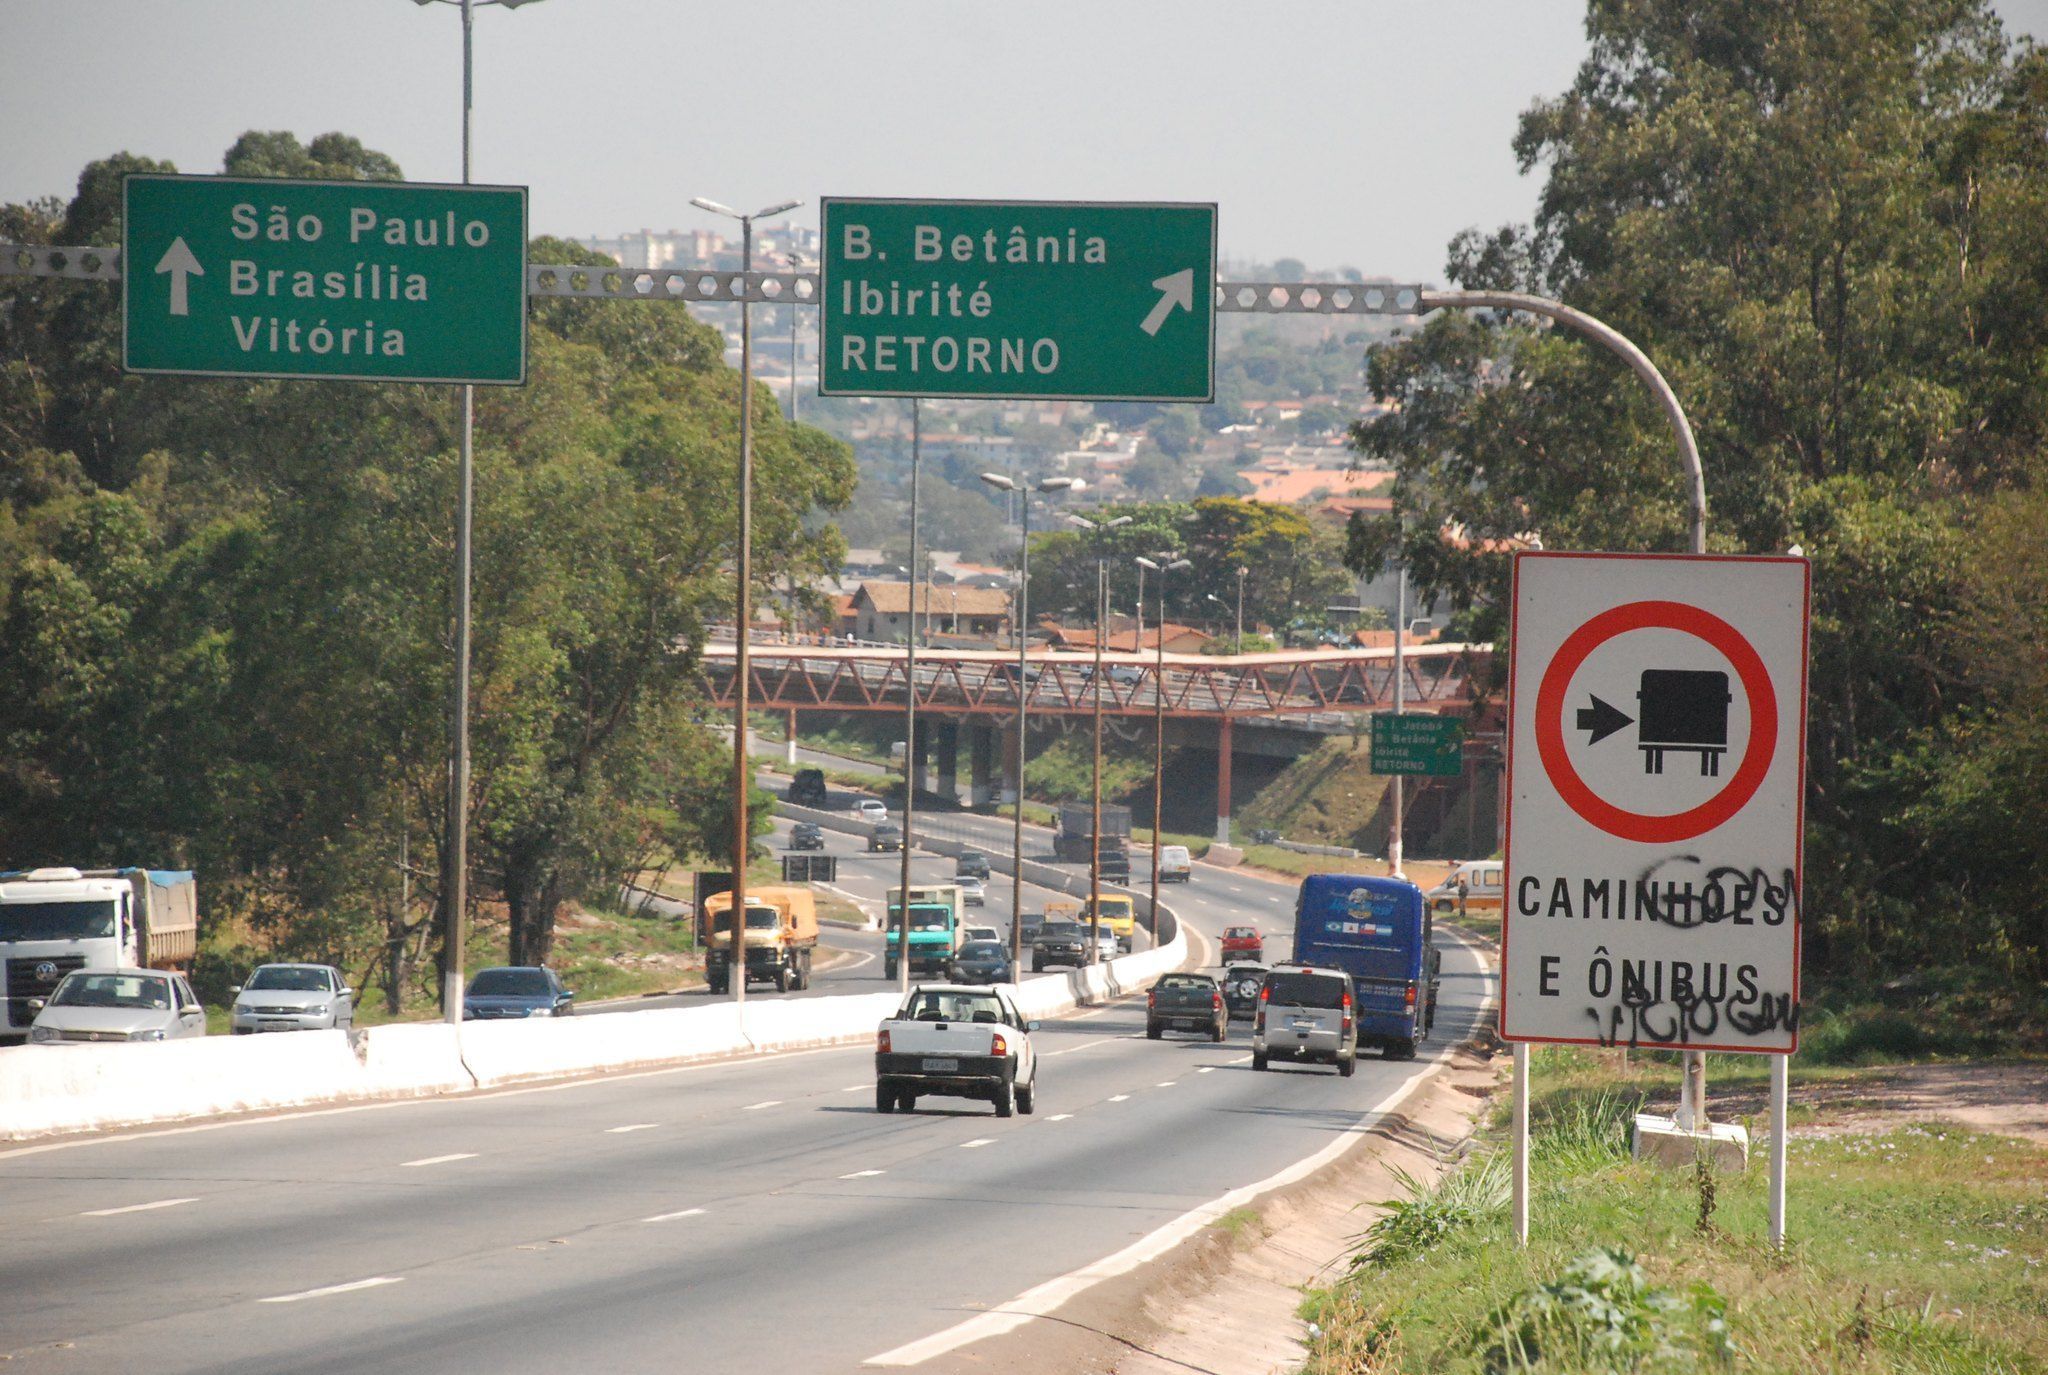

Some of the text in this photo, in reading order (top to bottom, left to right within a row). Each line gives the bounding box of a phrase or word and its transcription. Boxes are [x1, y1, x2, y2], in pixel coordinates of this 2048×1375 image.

[231, 203, 490, 247] São Paulo
[843, 225, 1107, 263] B. Betânia
[230, 260, 428, 301] Brasília
[843, 280, 992, 317] Ibirité
[230, 315, 405, 356] Vitória
[842, 335, 1060, 374] RETORNO
[1539, 945, 1760, 1005] E ÔNIBUS
